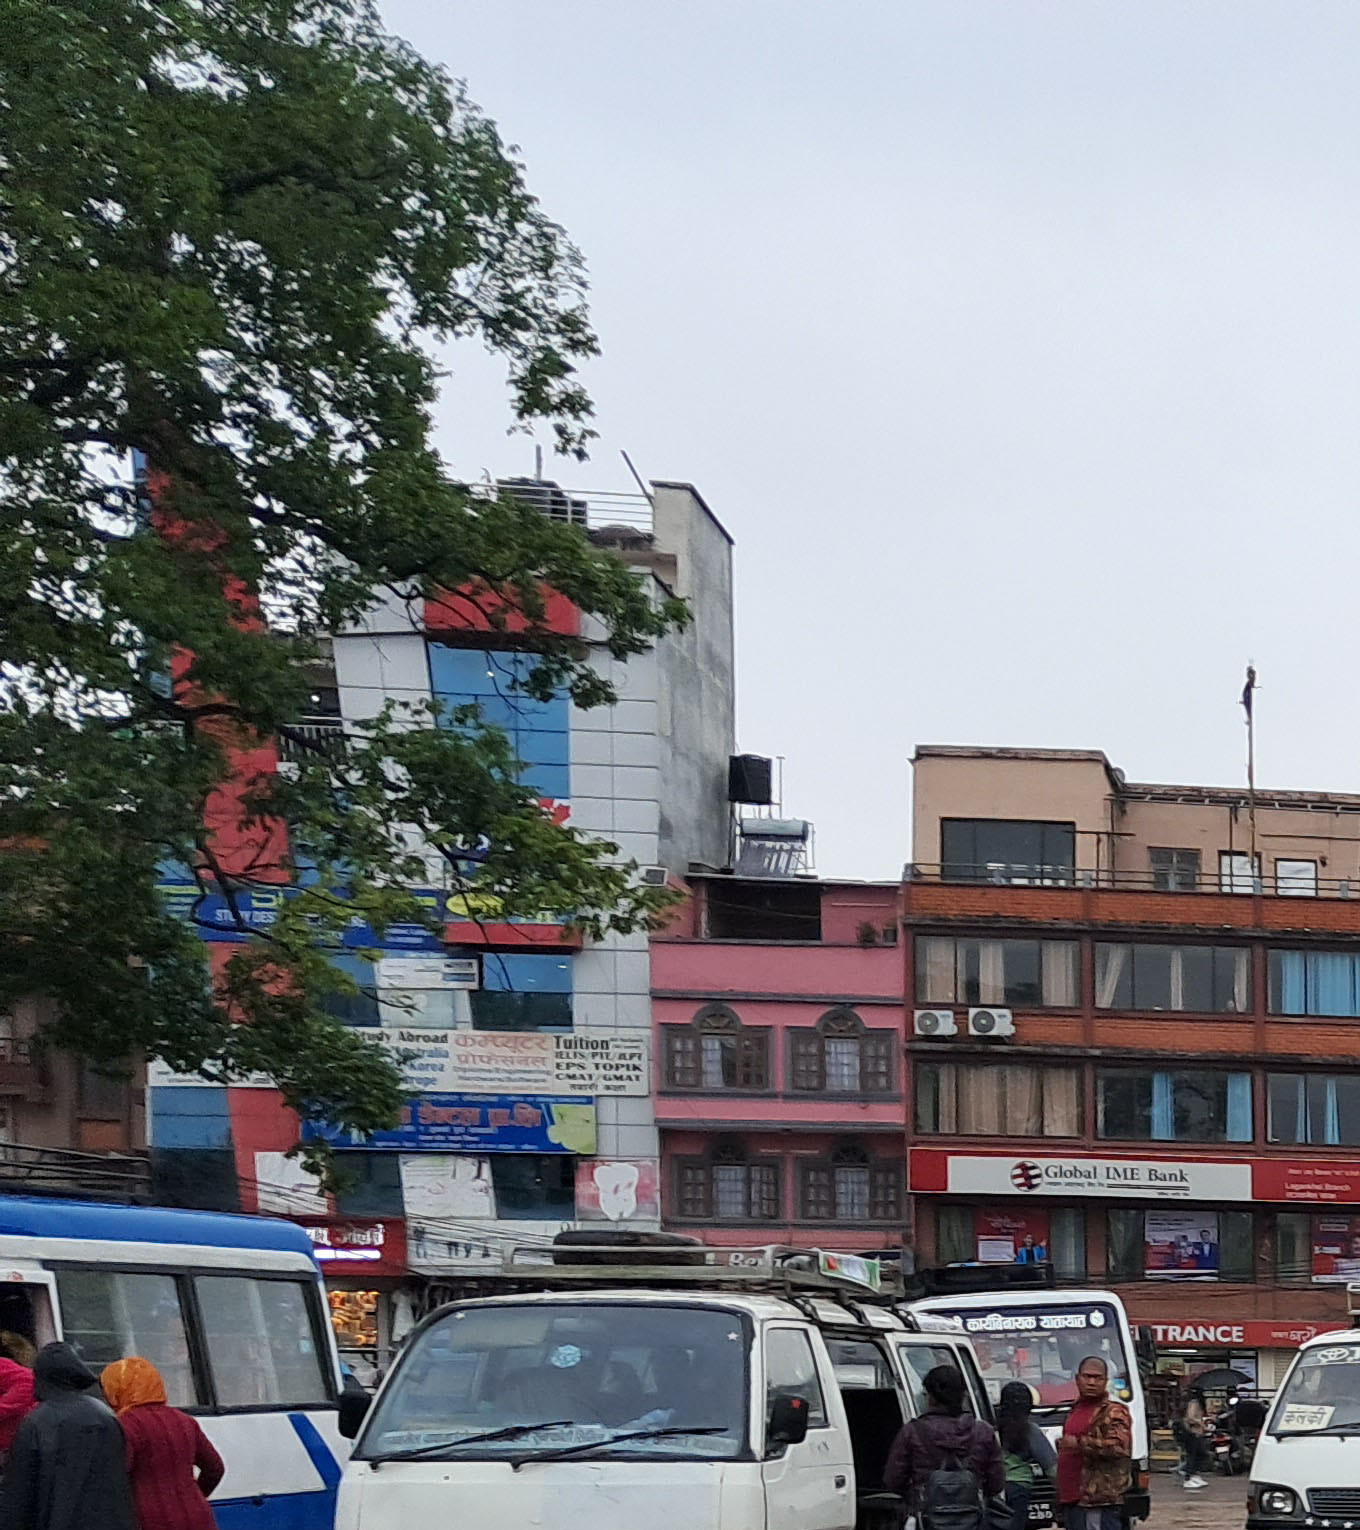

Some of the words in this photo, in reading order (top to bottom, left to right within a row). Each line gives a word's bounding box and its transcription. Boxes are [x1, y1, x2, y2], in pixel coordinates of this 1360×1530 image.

[553, 1035, 610, 1050] Tuition
[555, 1062, 587, 1071] EPS
[593, 1062, 643, 1072] TOPIK
[1044, 1164, 1098, 1180] Global
[1105, 1166, 1141, 1181] IME
[1148, 1168, 1190, 1184] Bank
